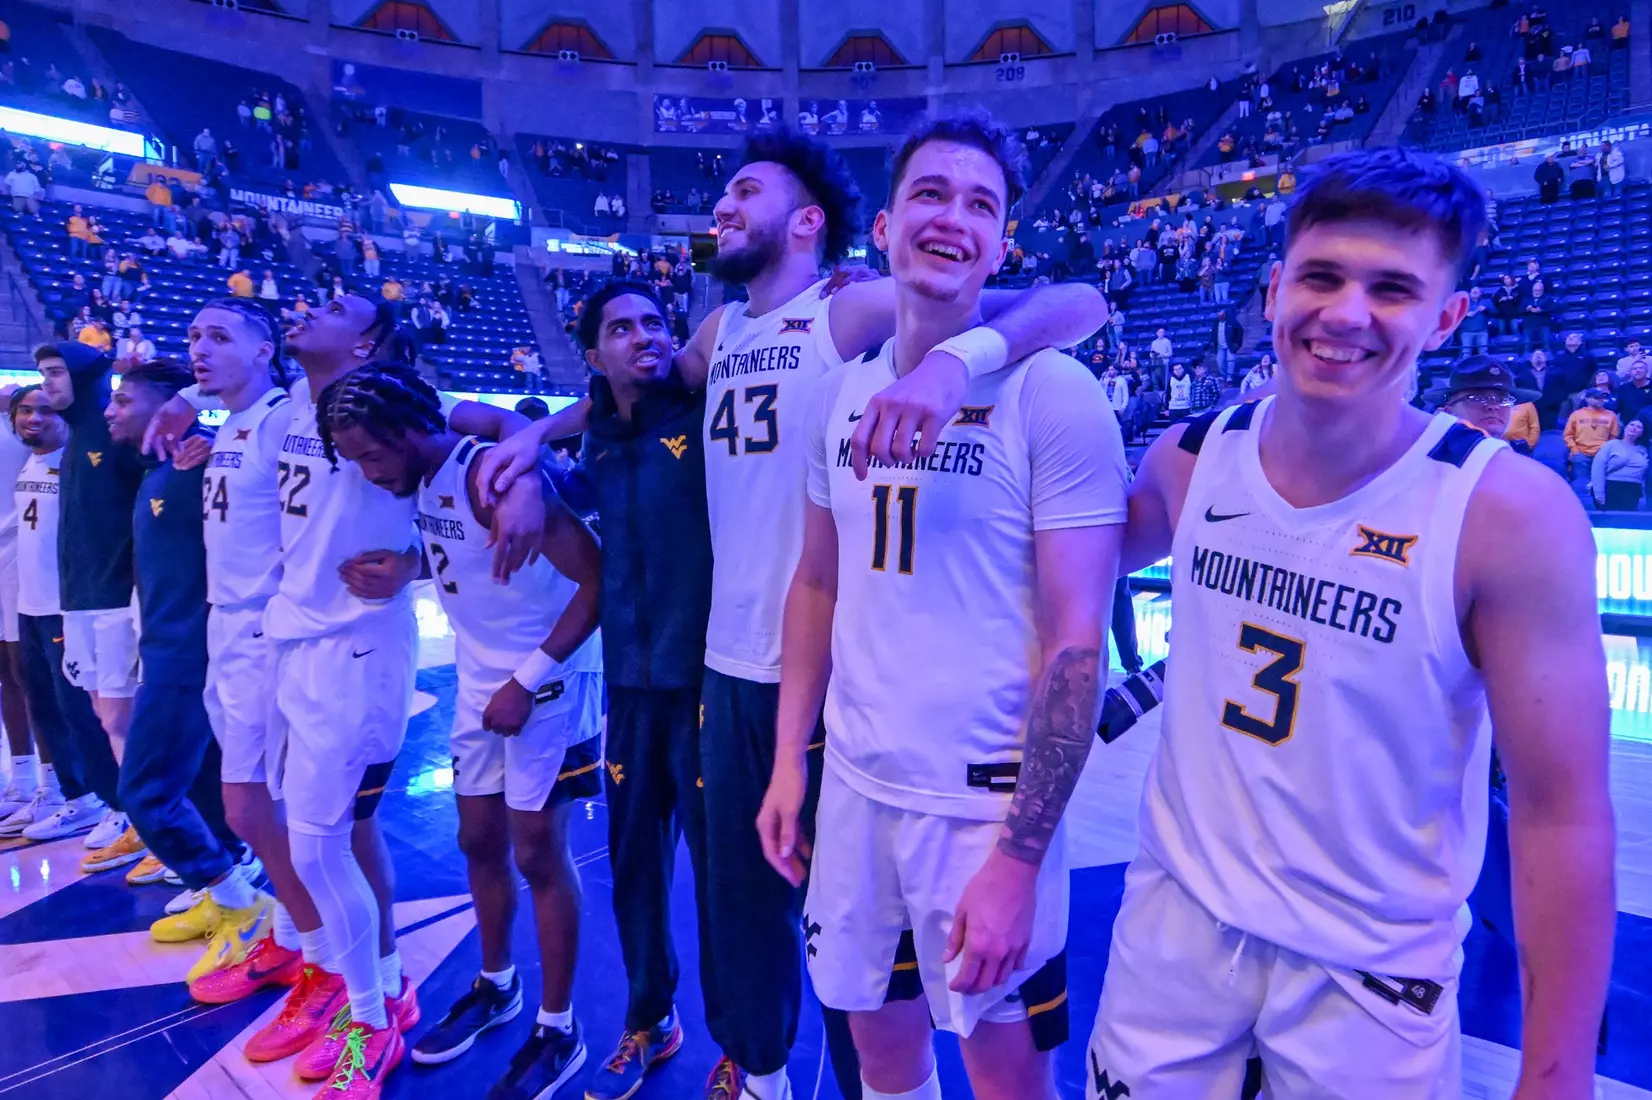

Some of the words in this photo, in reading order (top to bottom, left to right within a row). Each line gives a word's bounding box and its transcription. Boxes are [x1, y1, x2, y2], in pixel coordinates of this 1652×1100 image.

[709, 383, 780, 457] 43
[23, 498, 38, 531] 4
[871, 484, 919, 576] 11
[1348, 523, 1419, 569] XII
[430, 542, 460, 595] 2
[1191, 545, 1403, 645] MOUNTAINEERS
[1220, 620, 1307, 748] 3
